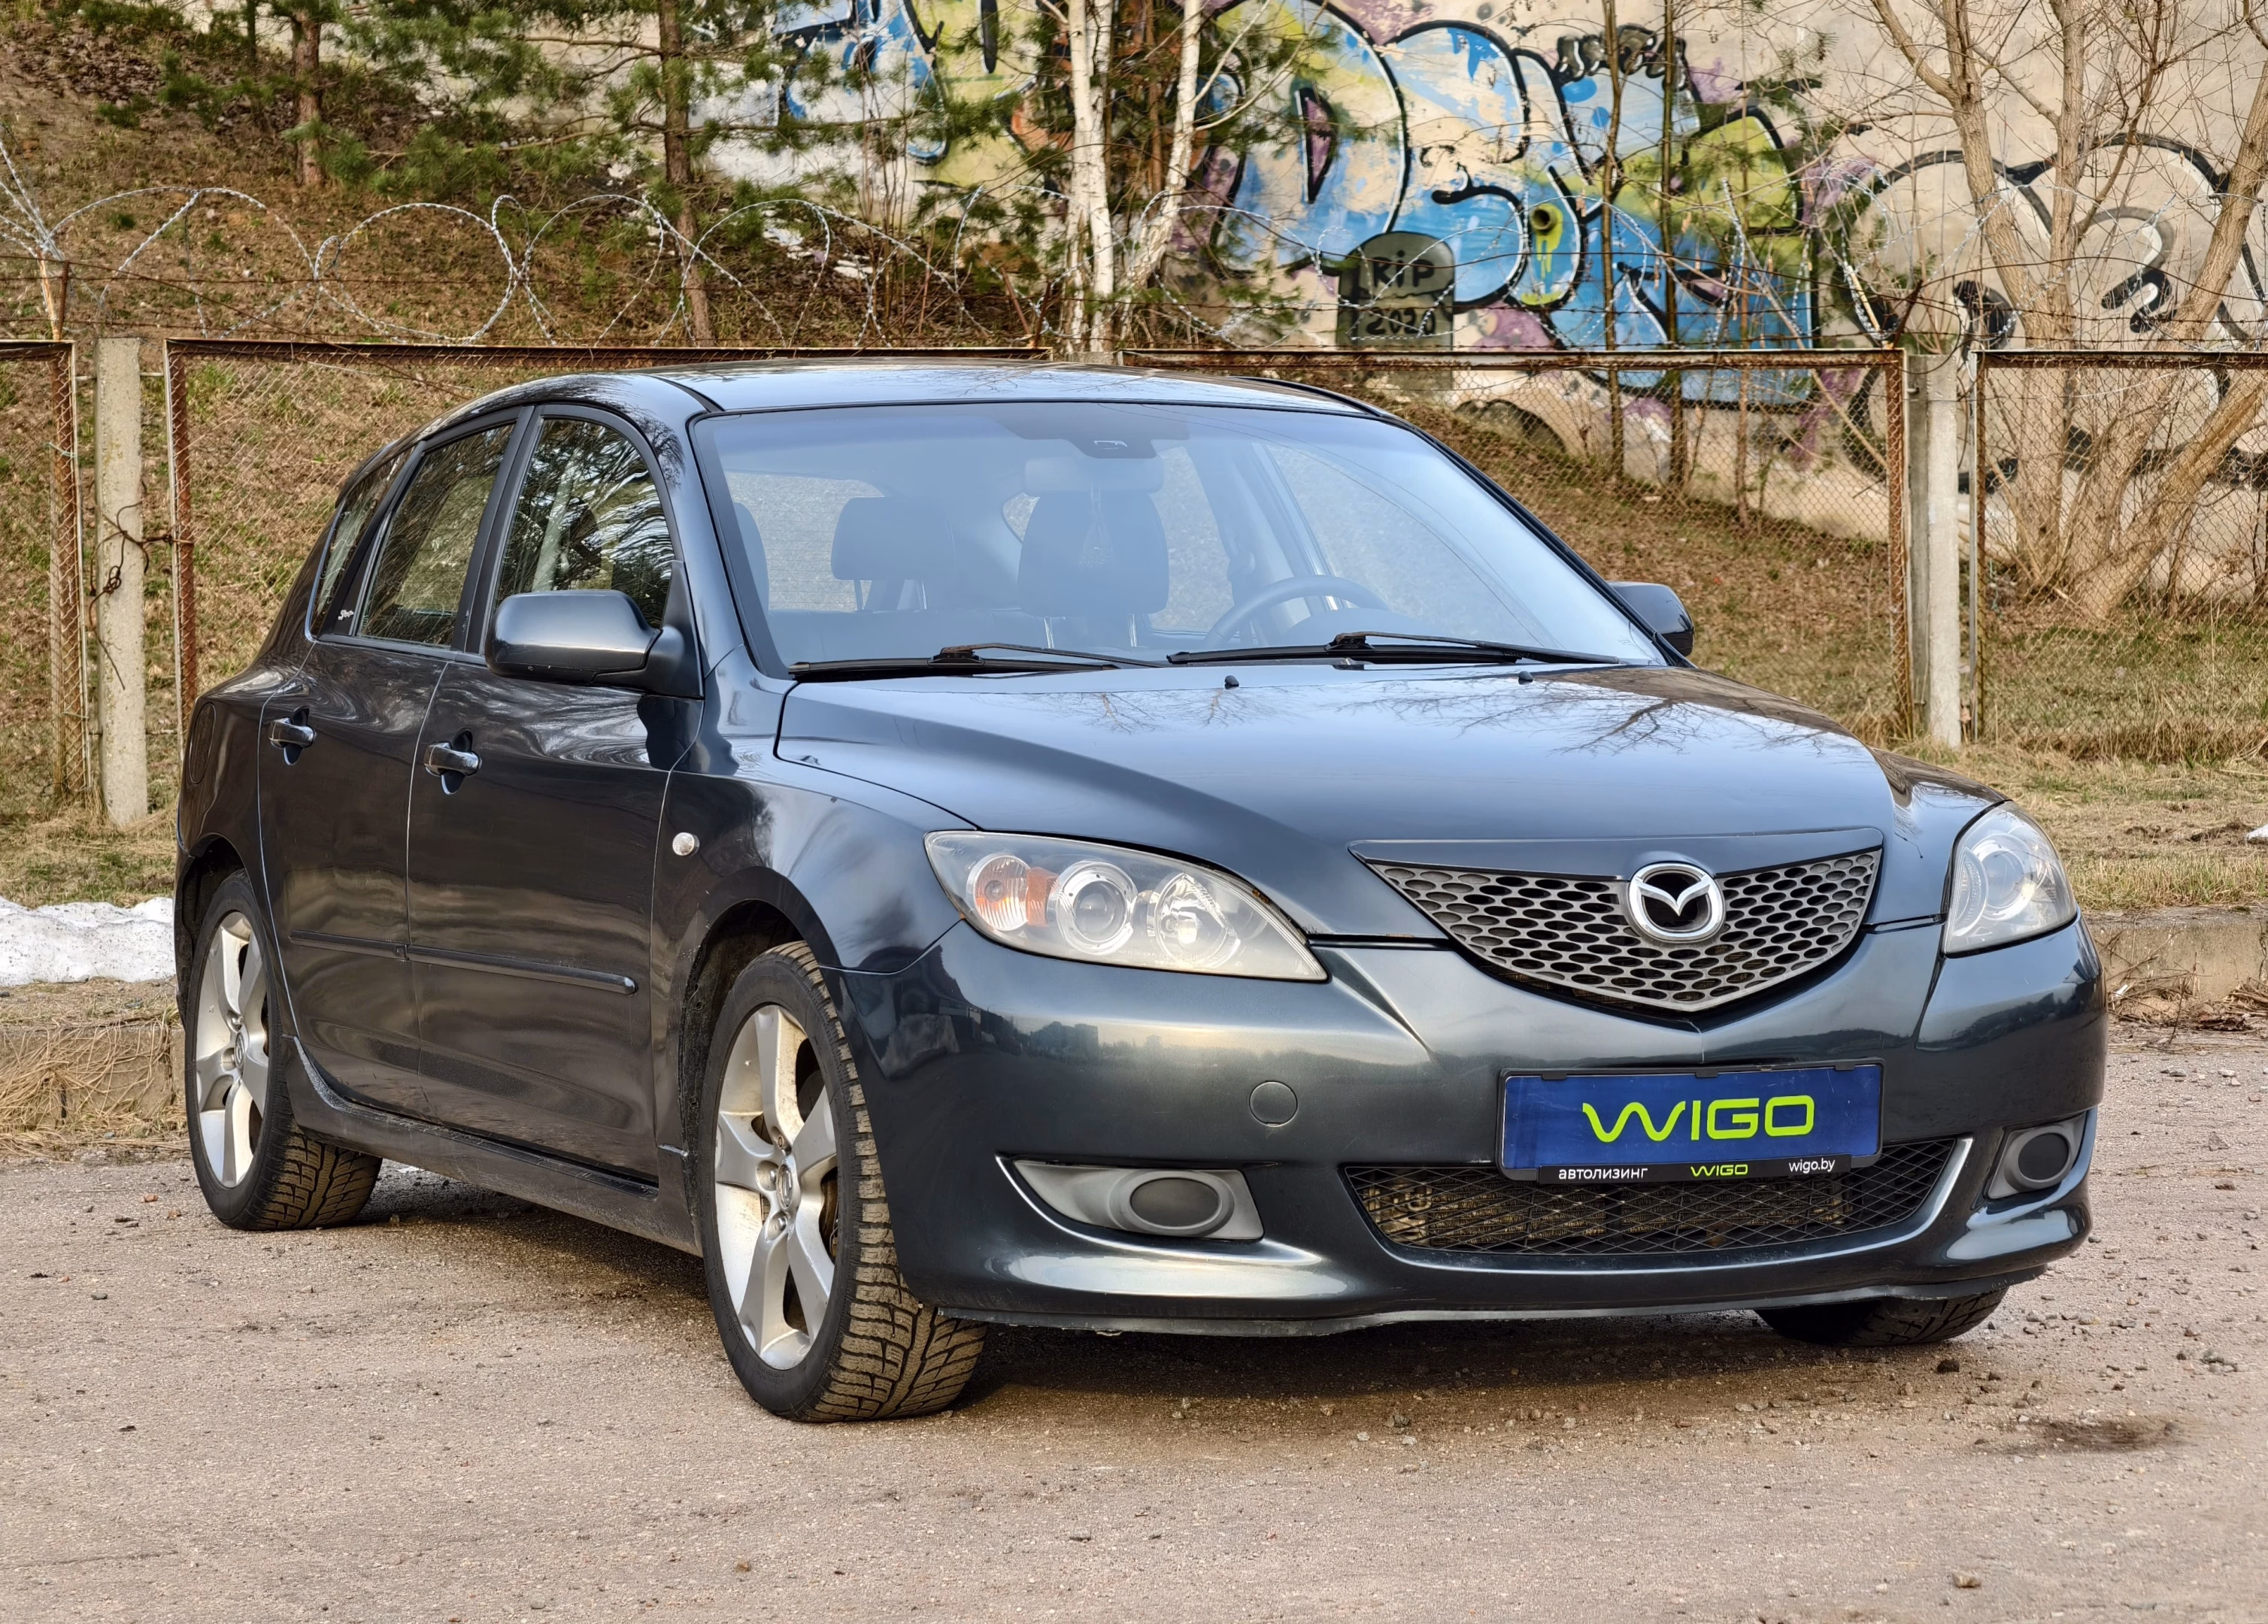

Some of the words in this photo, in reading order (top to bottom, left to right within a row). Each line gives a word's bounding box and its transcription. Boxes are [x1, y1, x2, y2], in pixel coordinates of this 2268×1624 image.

[1365, 306, 1436, 338] 2020
[1581, 1095, 1815, 1143] WIGO
[1558, 1166, 1648, 1180] автолизинг
[1690, 1164, 1748, 1177] WIGO
[1788, 1157, 1836, 1174] wigo.by
